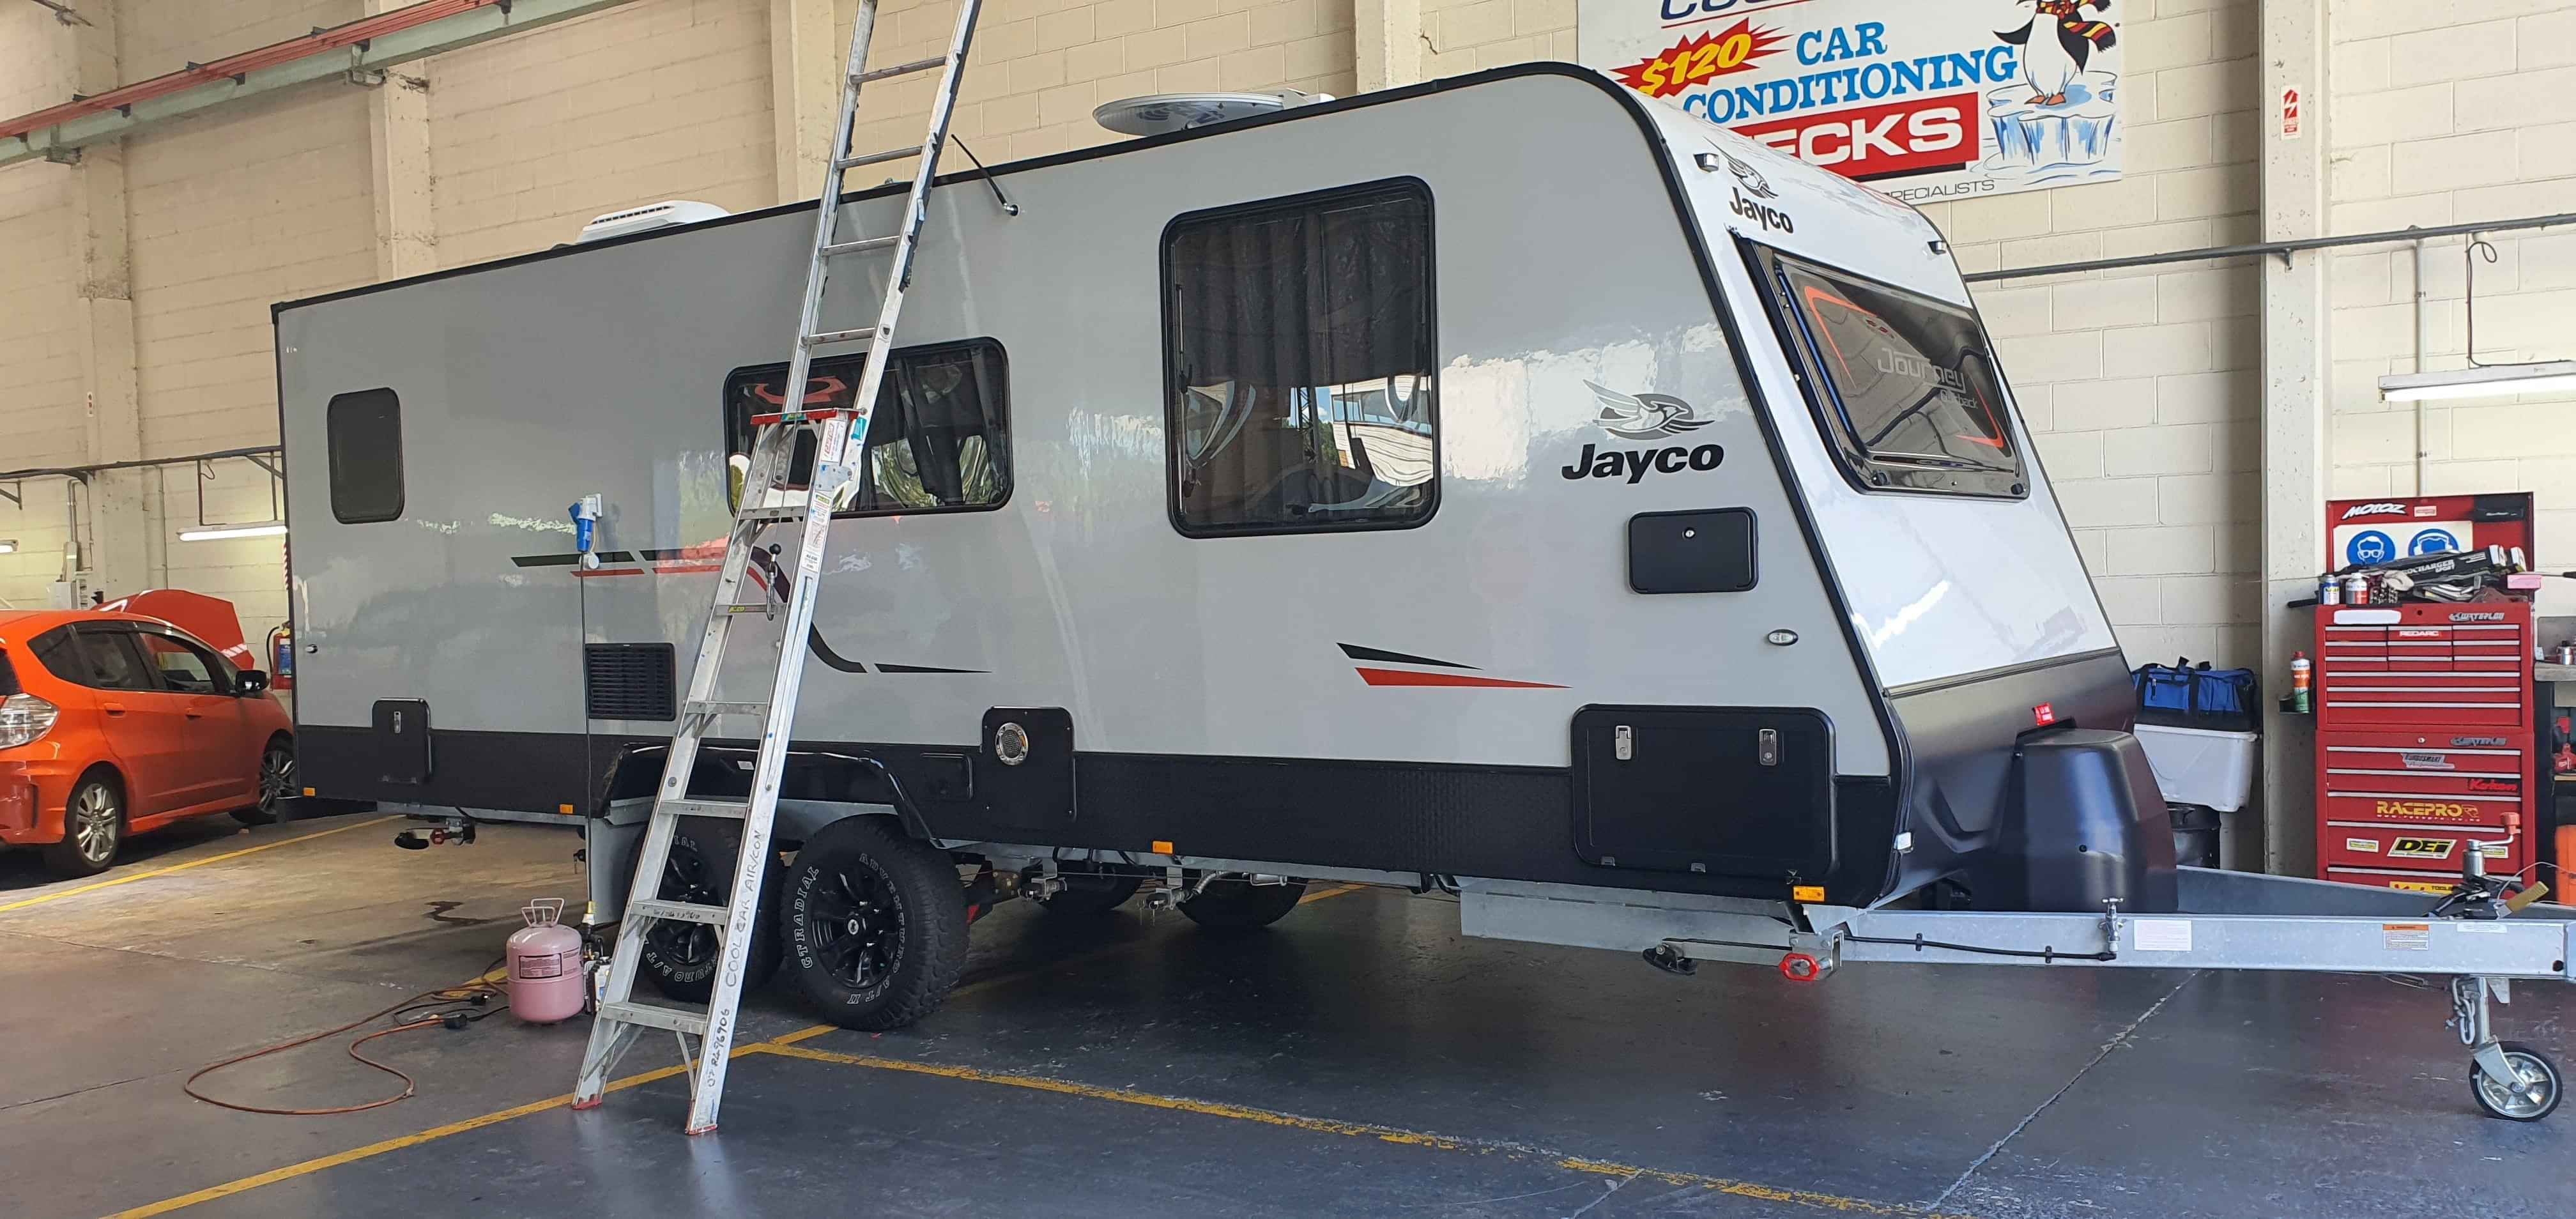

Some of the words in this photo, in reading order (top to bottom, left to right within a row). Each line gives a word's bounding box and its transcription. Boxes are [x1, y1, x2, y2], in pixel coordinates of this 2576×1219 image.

[1637, 33, 1752, 96] $120
[1797, 22, 1888, 65] CAR
[1683, 45, 2018, 125] CONDITIONING
[1753, 107, 1963, 166] ECKS
[1729, 186, 1793, 233] Jayco
[1885, 180, 1995, 201] PECIALISTS
[1878, 348, 1966, 394] Journey
[1561, 443, 1724, 484] Jayco
[2377, 801, 2462, 817] RACEPRO
[725, 936, 742, 988] COOL
